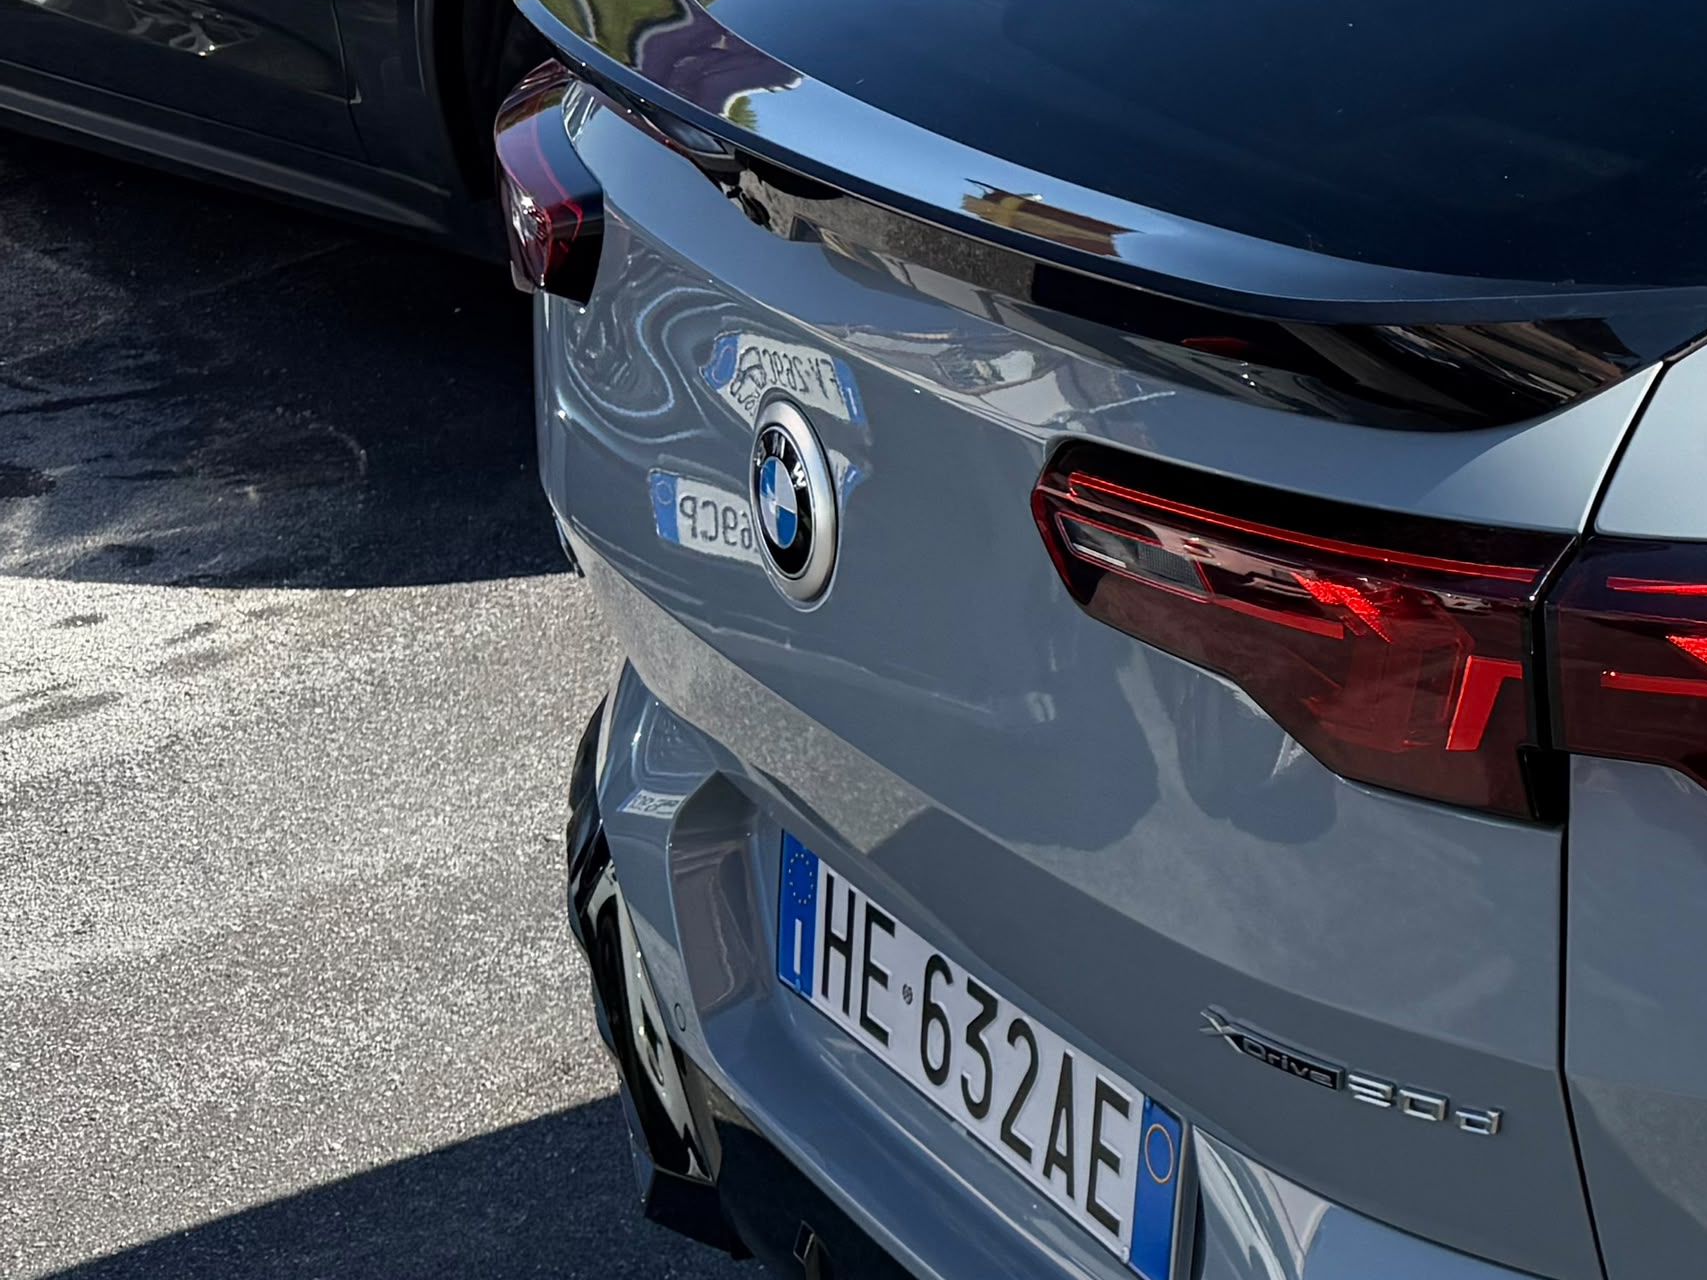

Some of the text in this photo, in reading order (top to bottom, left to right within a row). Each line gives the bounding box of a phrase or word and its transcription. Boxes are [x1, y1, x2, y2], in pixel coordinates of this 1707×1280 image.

[820, 871, 1131, 1238] HE 632AE
[1348, 1071, 1503, 1135] 20d
